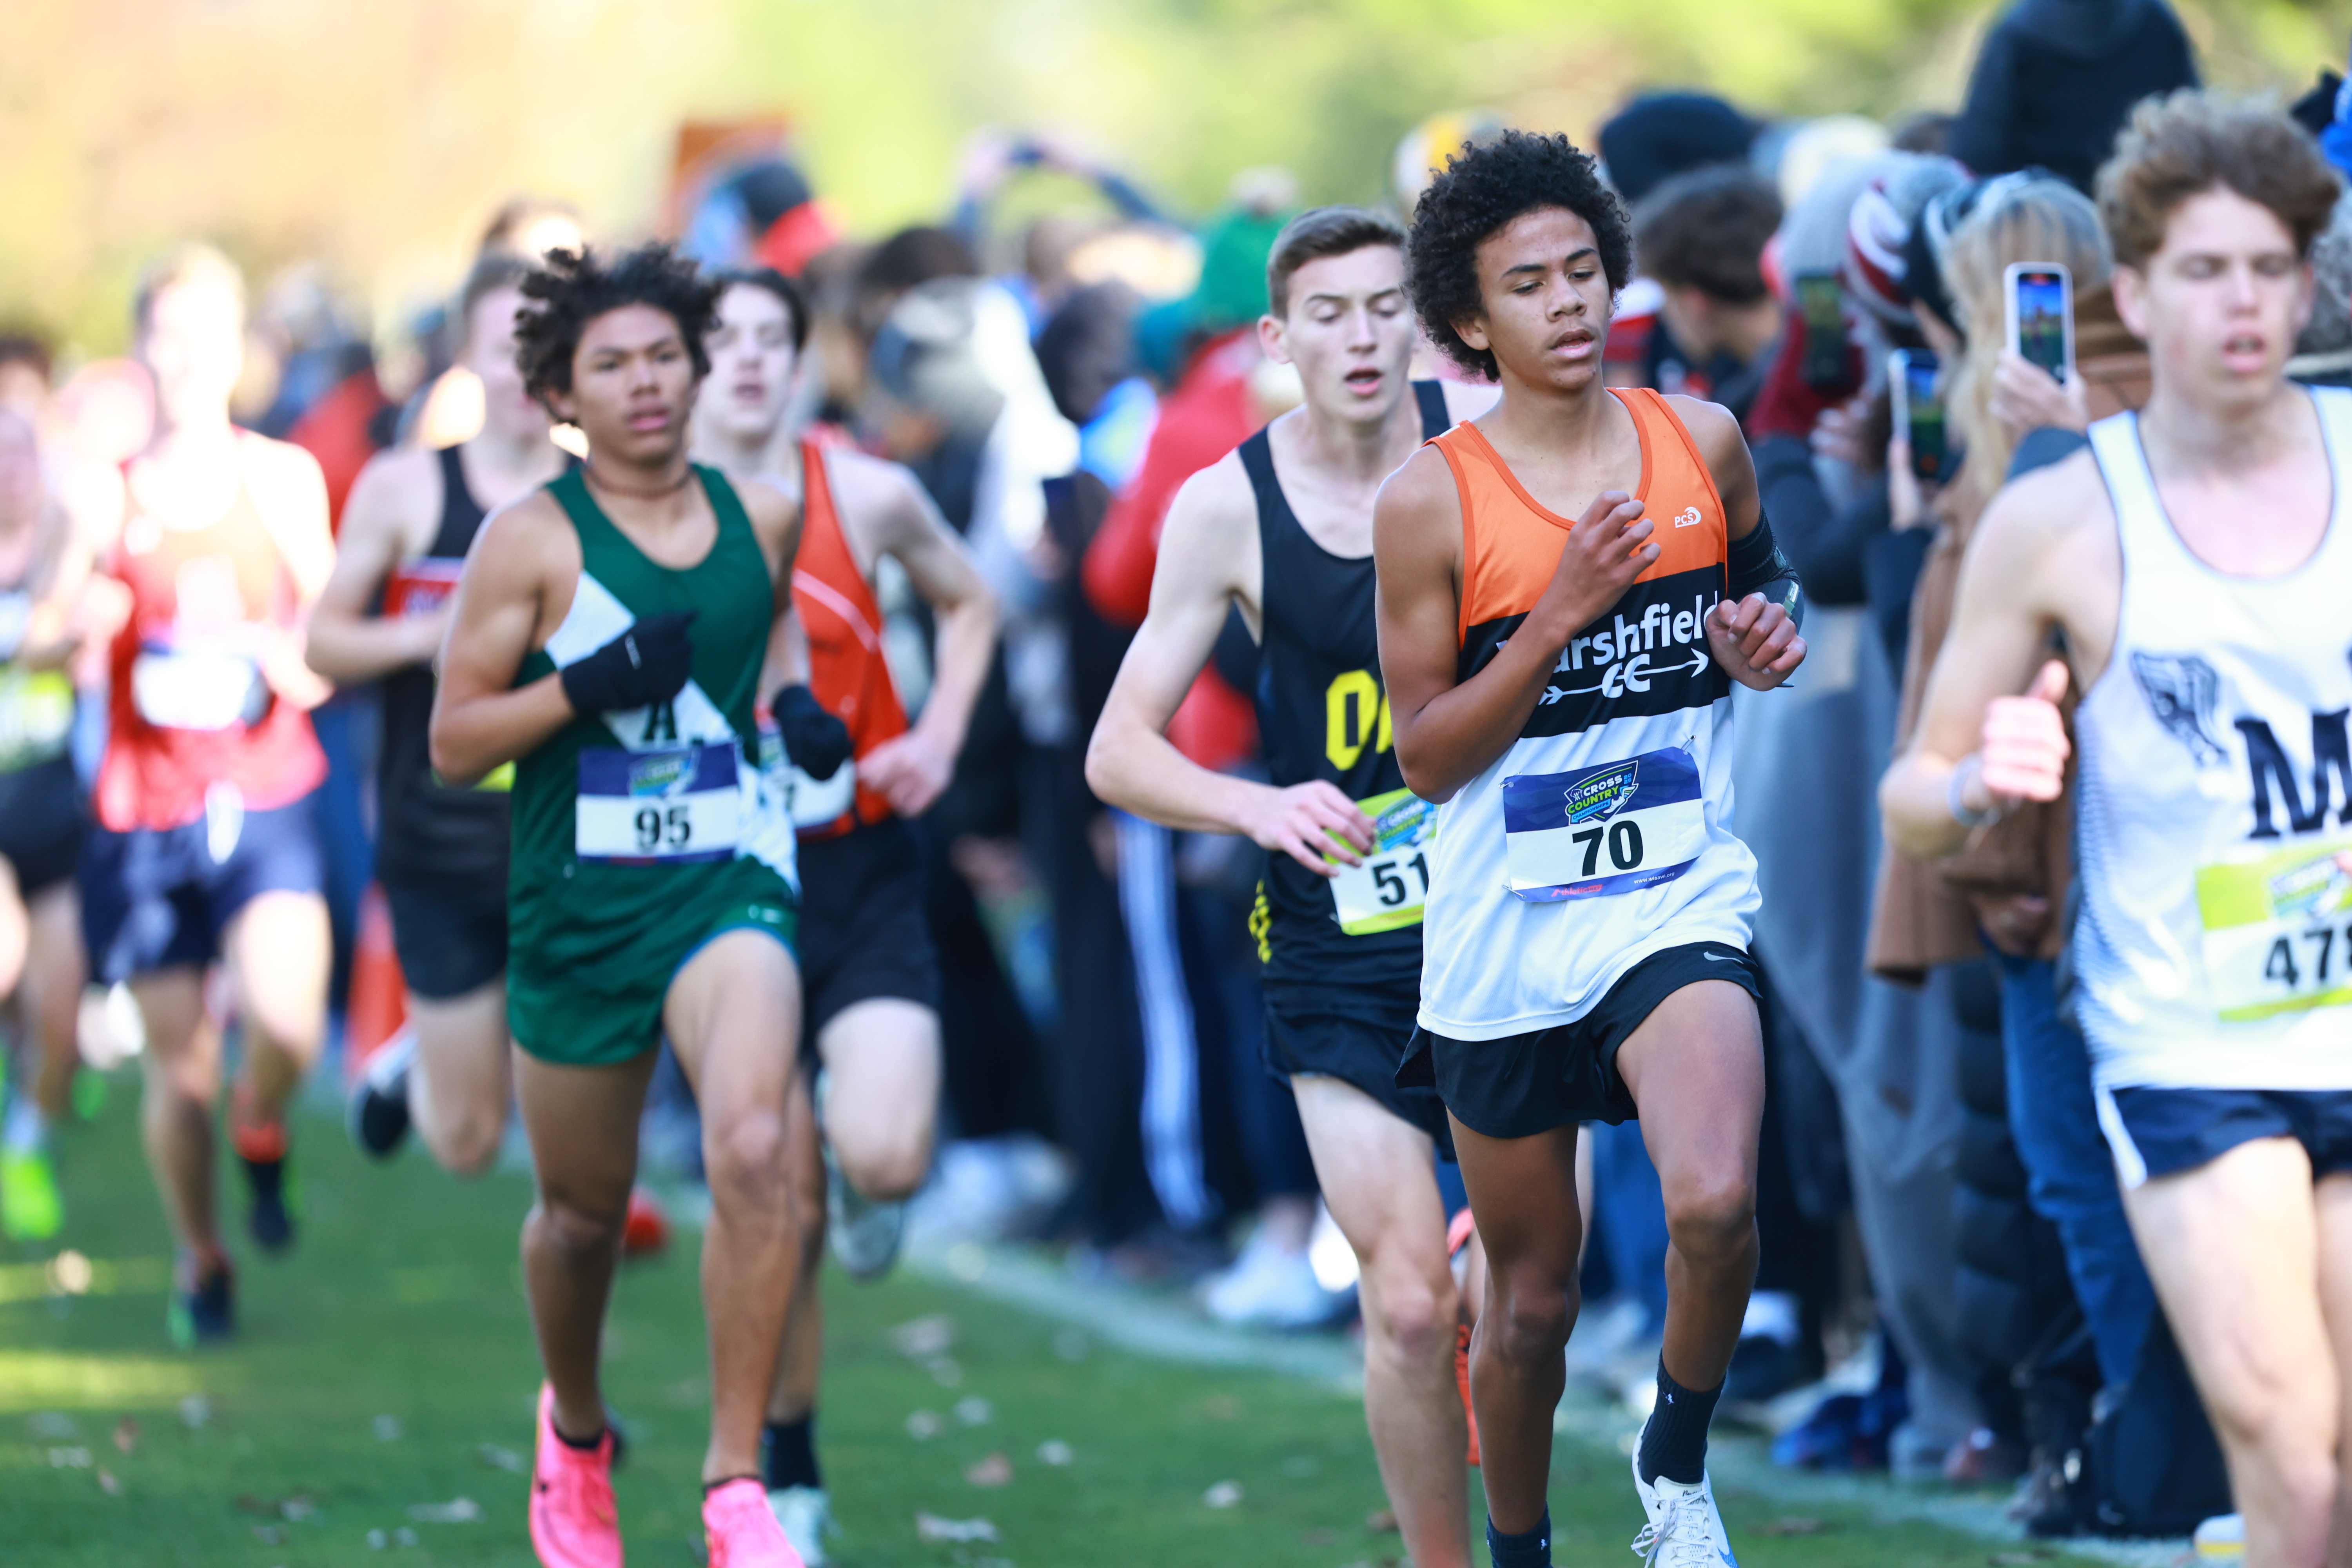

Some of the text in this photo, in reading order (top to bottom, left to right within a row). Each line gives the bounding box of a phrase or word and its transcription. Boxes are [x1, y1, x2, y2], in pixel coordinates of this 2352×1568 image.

[1674, 514, 1693, 526] PCS
[1496, 591, 1718, 674] rshfiel
[1602, 653, 1650, 698] CC
[1326, 669, 1393, 771] O
[1568, 785, 1619, 813] COUNTRY
[1583, 775, 1622, 796] CROSS
[636, 806, 690, 849] 95
[1573, 801, 1609, 820] CHAMPIONSHIPS
[1572, 820, 1643, 877] 70
[1373, 852, 1429, 905] 51
[1633, 872, 1675, 884] www.wiaawi.org
[2266, 924, 2352, 987] 47
